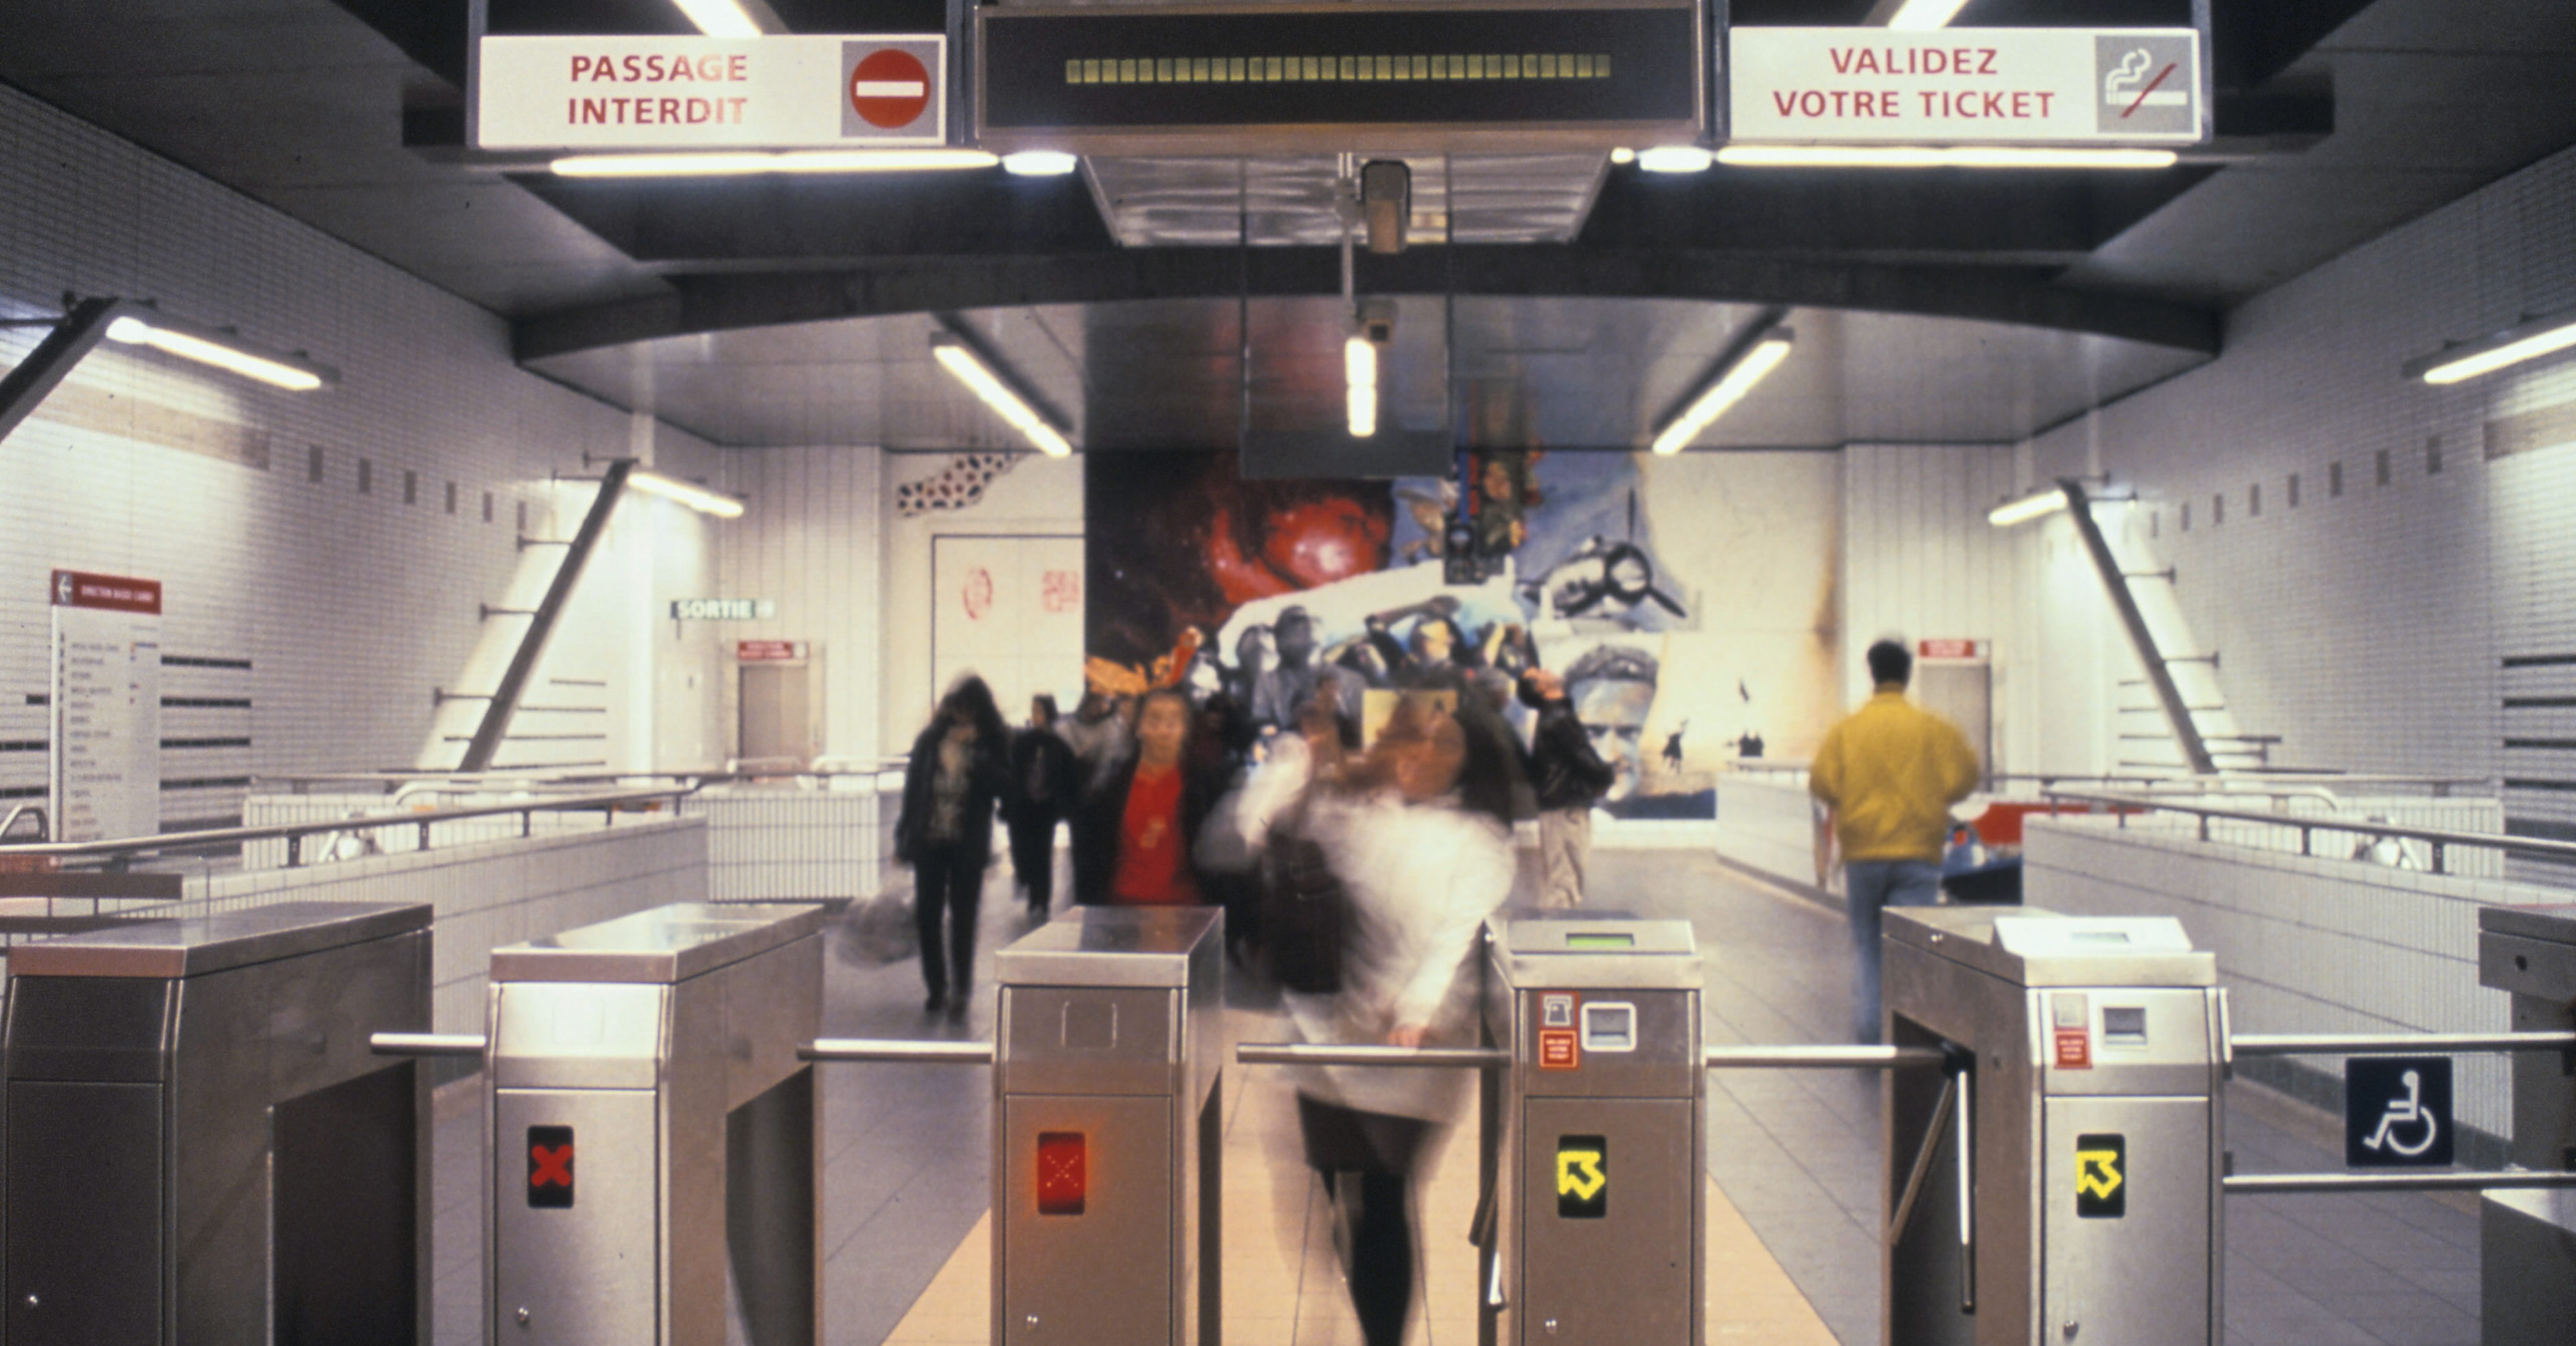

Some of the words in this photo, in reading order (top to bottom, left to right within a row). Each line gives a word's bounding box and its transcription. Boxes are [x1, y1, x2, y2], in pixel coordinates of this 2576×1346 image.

[570, 54, 747, 83] PASSAGE
[1829, 47, 1997, 75] VALIDEZ
[568, 97, 747, 125] INTERDIT
[1773, 89, 1900, 118] VOTRE
[1918, 90, 2054, 118] TICKET
[678, 599, 752, 619] SORTIE
